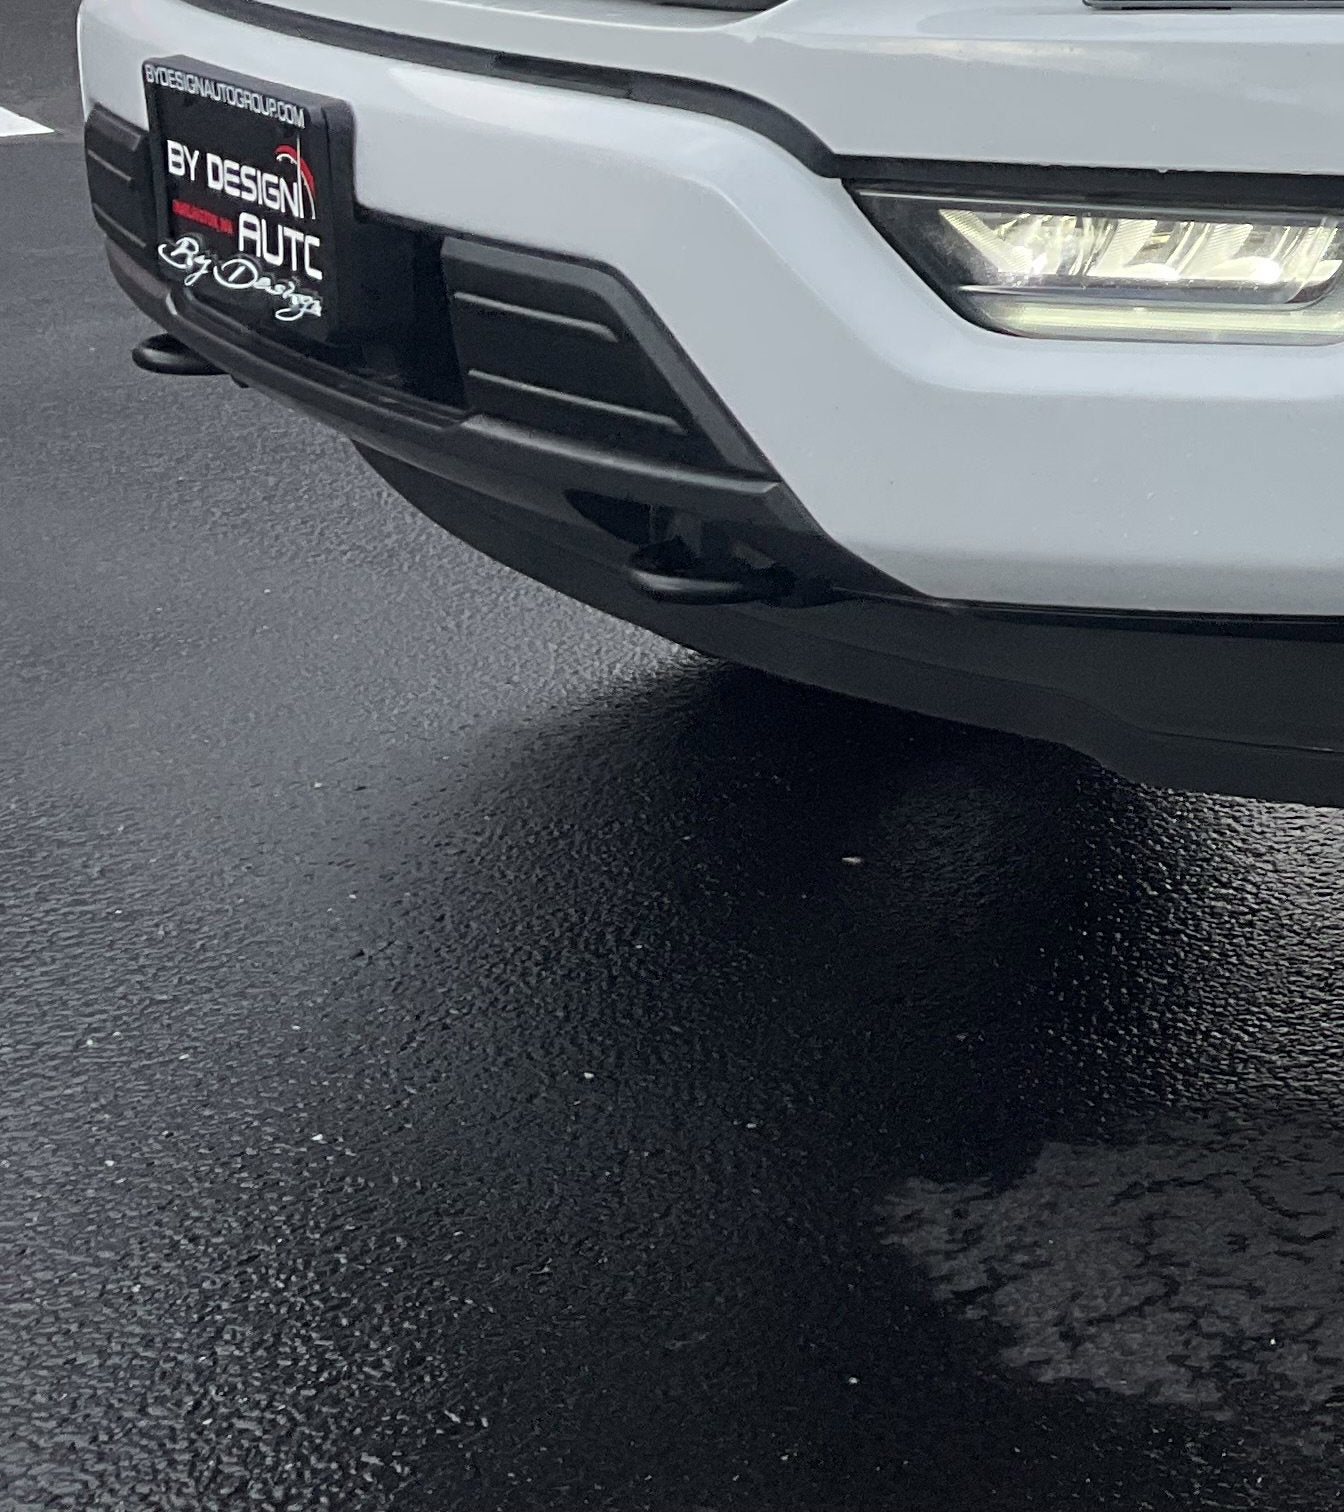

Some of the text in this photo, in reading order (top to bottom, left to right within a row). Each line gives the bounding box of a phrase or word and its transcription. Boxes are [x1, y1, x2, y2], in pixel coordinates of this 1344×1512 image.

[145, 63, 305, 129] BYDESIGNAUTOGROUP.COM
[166, 139, 200, 182] BY
[206, 152, 300, 217] DESIGN
